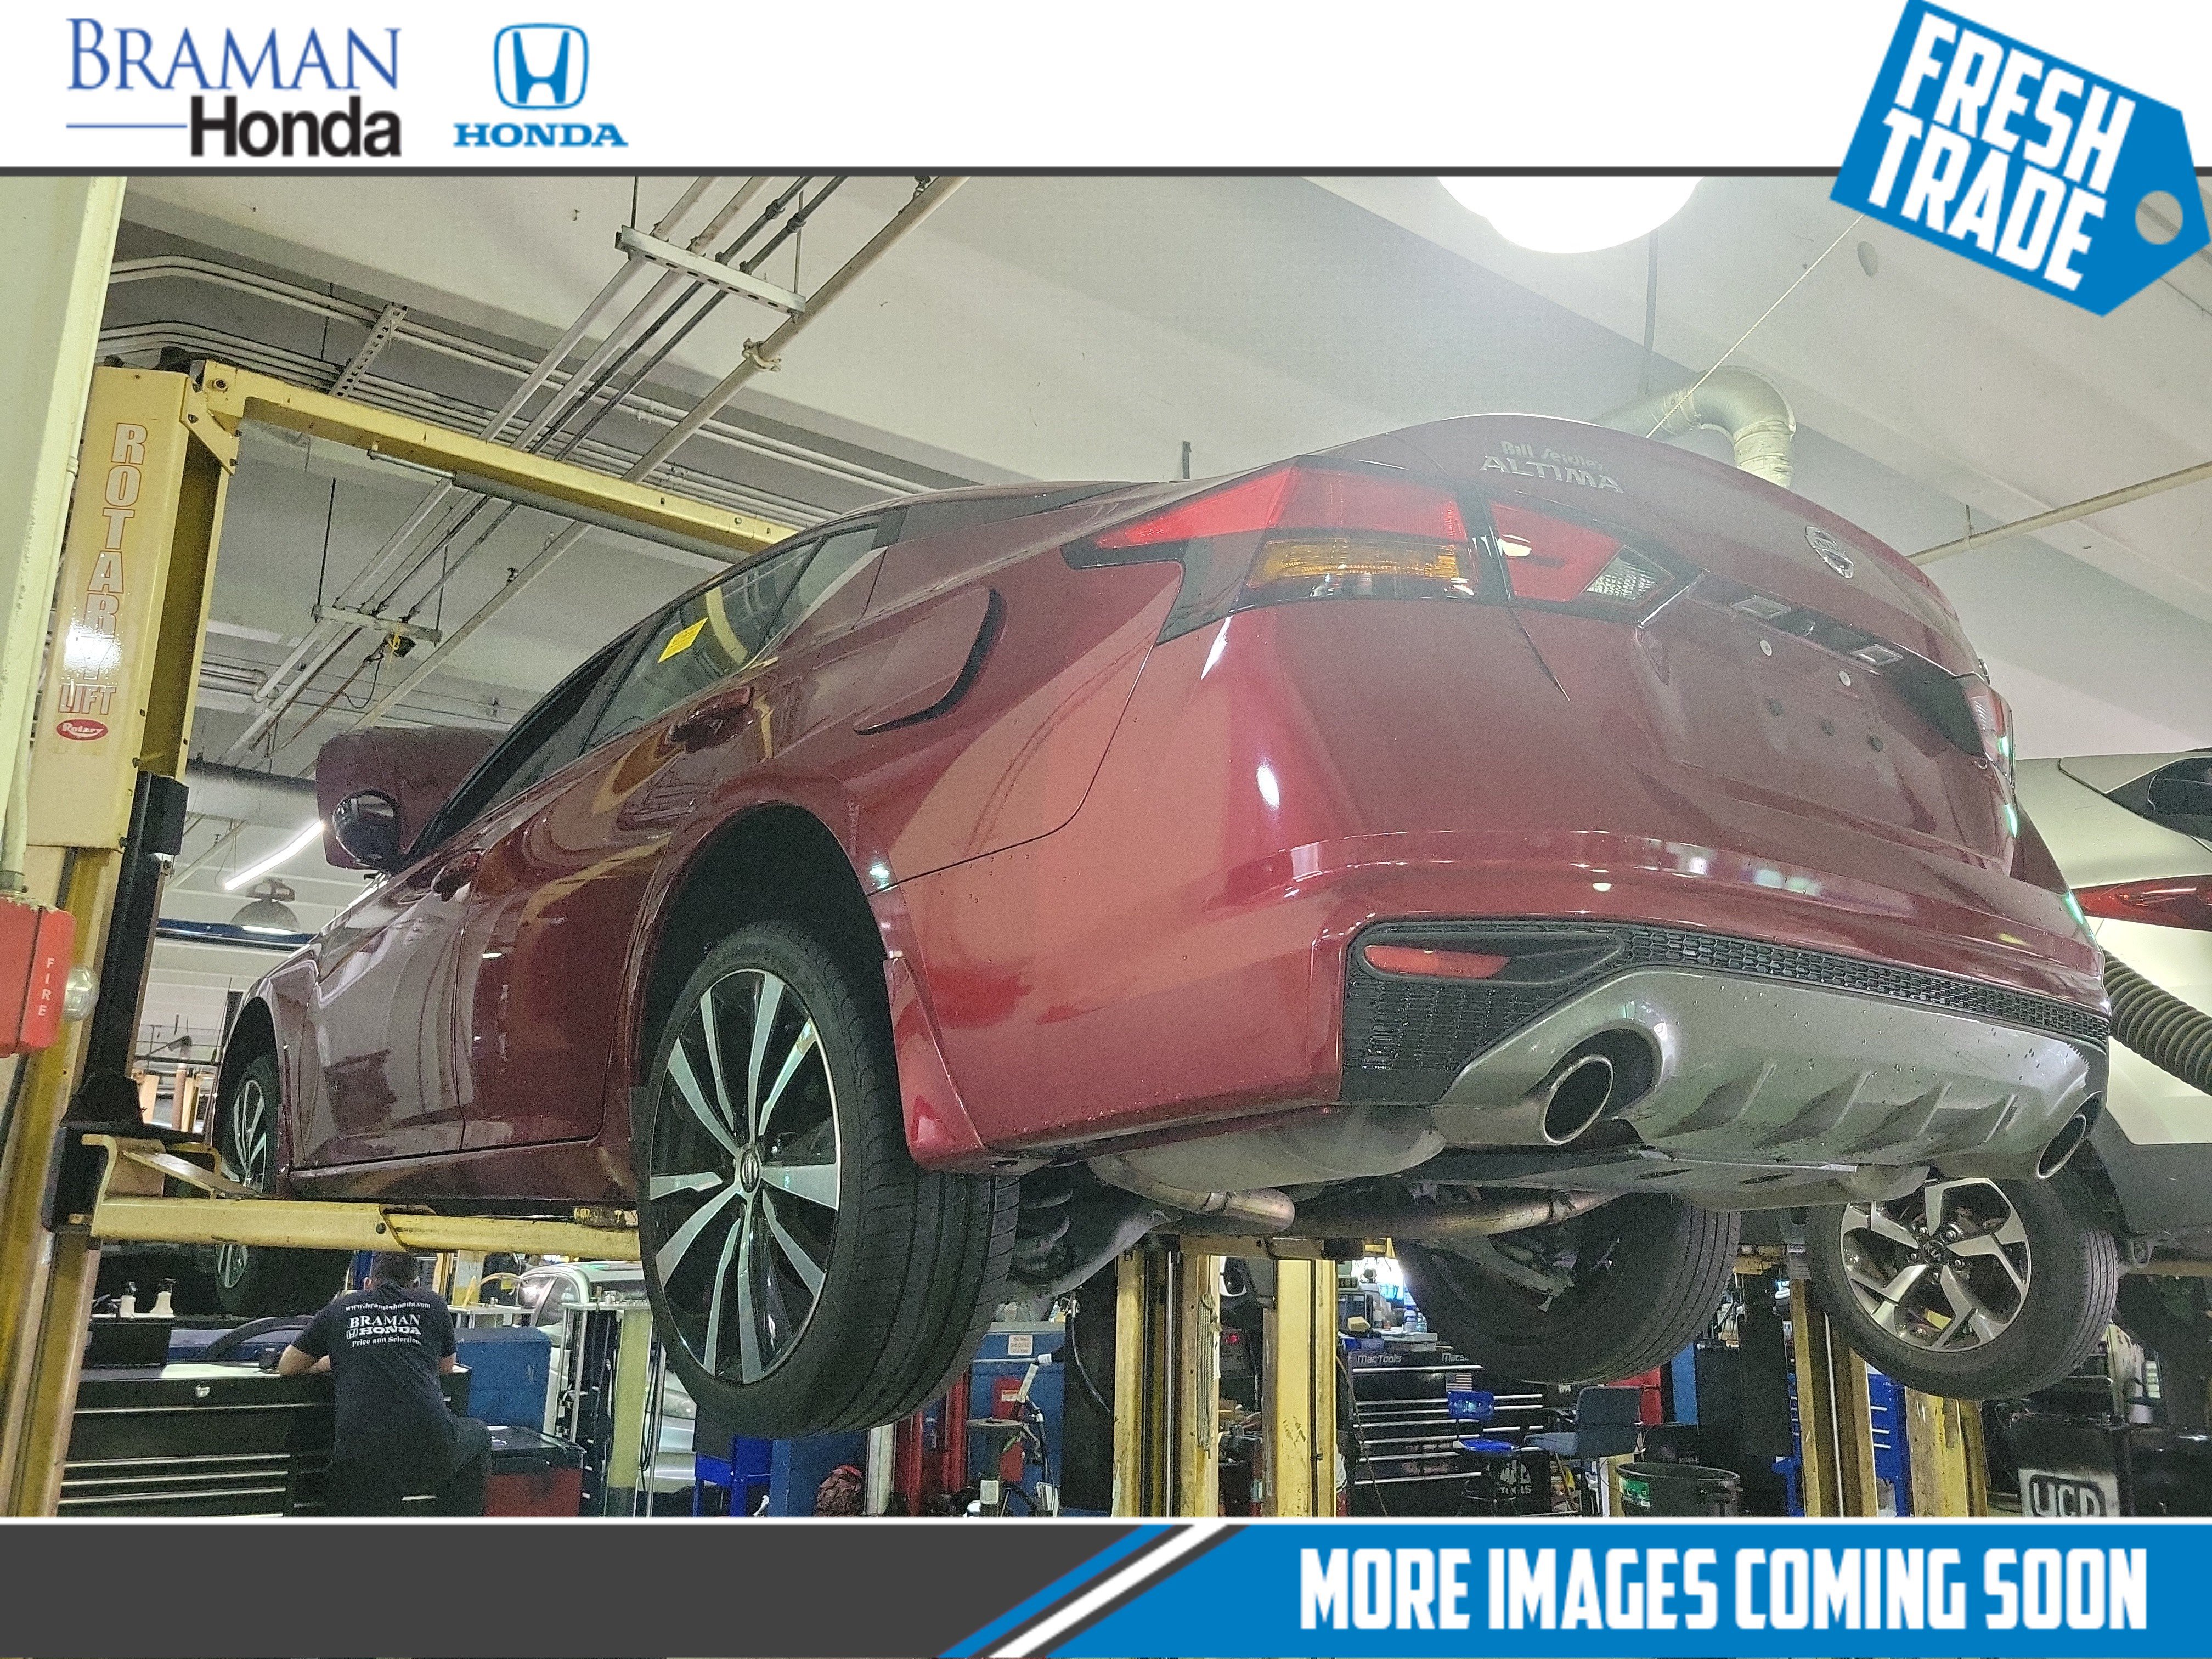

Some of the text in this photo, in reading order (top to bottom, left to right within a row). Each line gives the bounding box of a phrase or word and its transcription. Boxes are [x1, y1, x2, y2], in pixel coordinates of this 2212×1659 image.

[1500, 441, 1534, 459] Bill
[1479, 455, 1624, 493] ALTIMA
[77, 422, 148, 680] ROTARY
[58, 684, 116, 715] LIFT
[37, 957, 55, 1017] FIRE
[349, 1314, 421, 1329] BRAMAN
[359, 1325, 421, 1336] HONDA
[352, 1339, 370, 1348] Price
